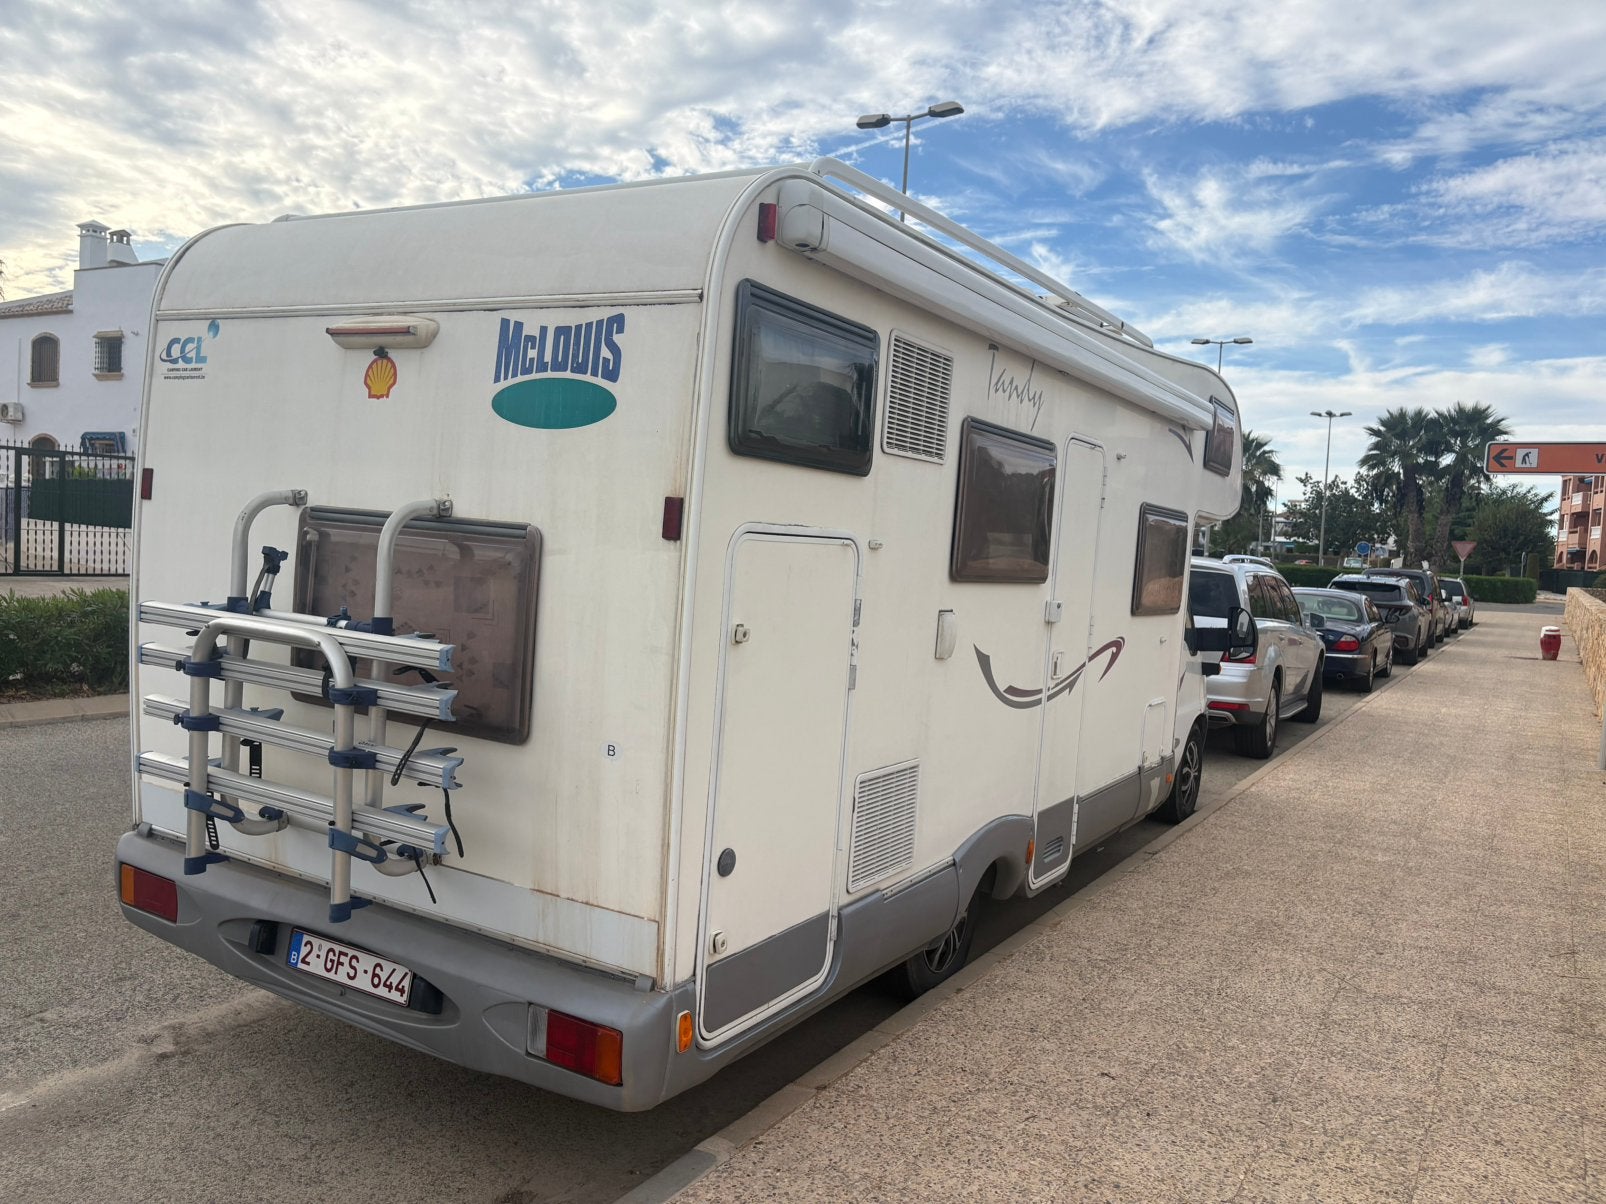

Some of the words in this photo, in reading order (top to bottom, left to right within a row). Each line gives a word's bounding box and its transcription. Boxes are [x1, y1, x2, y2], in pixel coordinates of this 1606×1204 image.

[165, 336, 208, 365] CCL
[493, 312, 626, 384] McLOUIS
[987, 343, 1045, 432] Tandy
[1595, 453, 1606, 464] V
[607, 744, 616, 757] B
[290, 951, 298, 963] B
